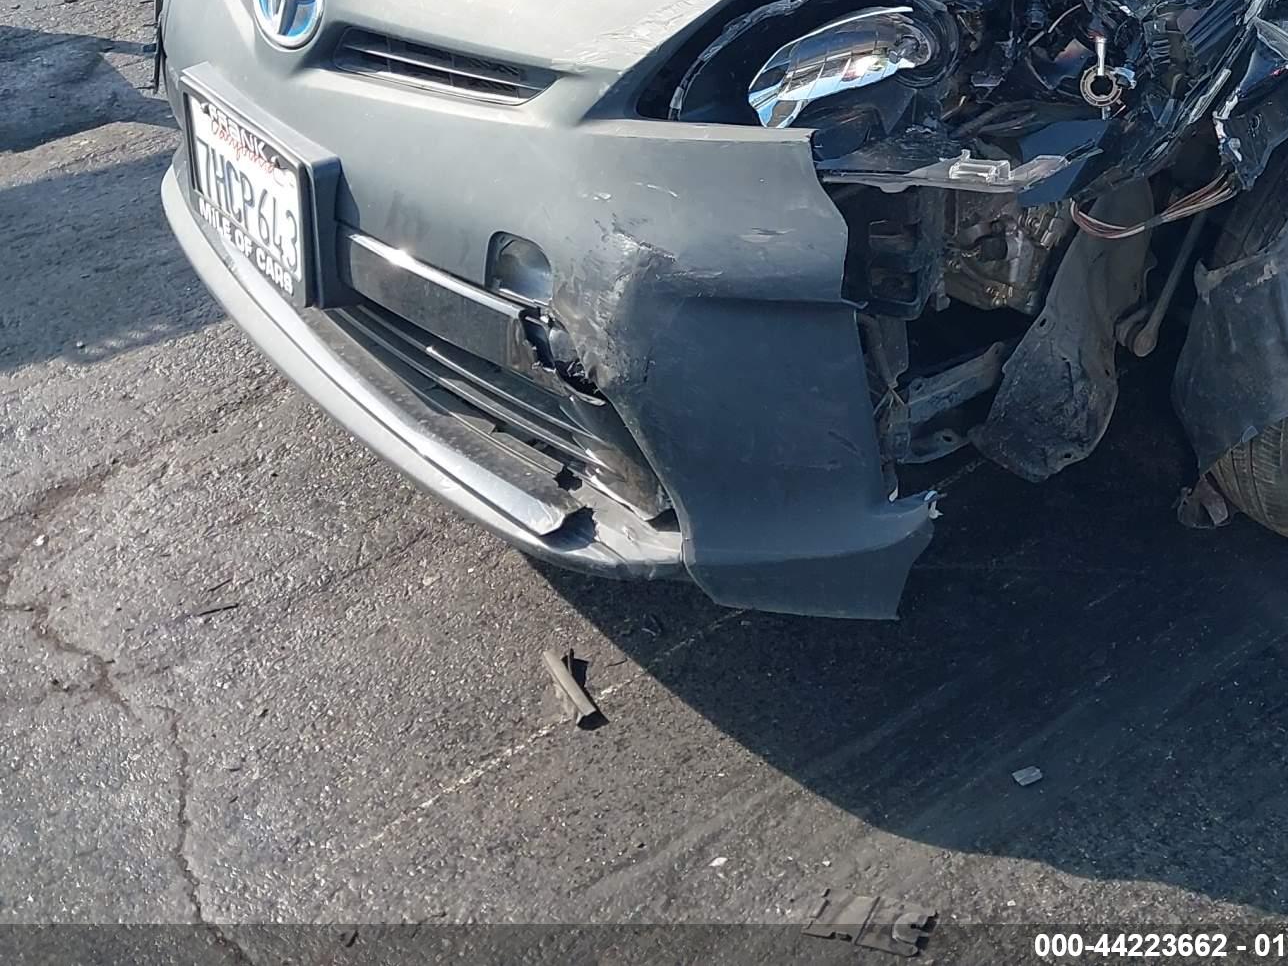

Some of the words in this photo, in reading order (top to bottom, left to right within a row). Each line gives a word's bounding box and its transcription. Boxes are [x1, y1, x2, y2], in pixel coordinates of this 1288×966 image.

[199, 196, 234, 244] MILE
[234, 228, 253, 258] OF
[255, 246, 294, 297] CARS
